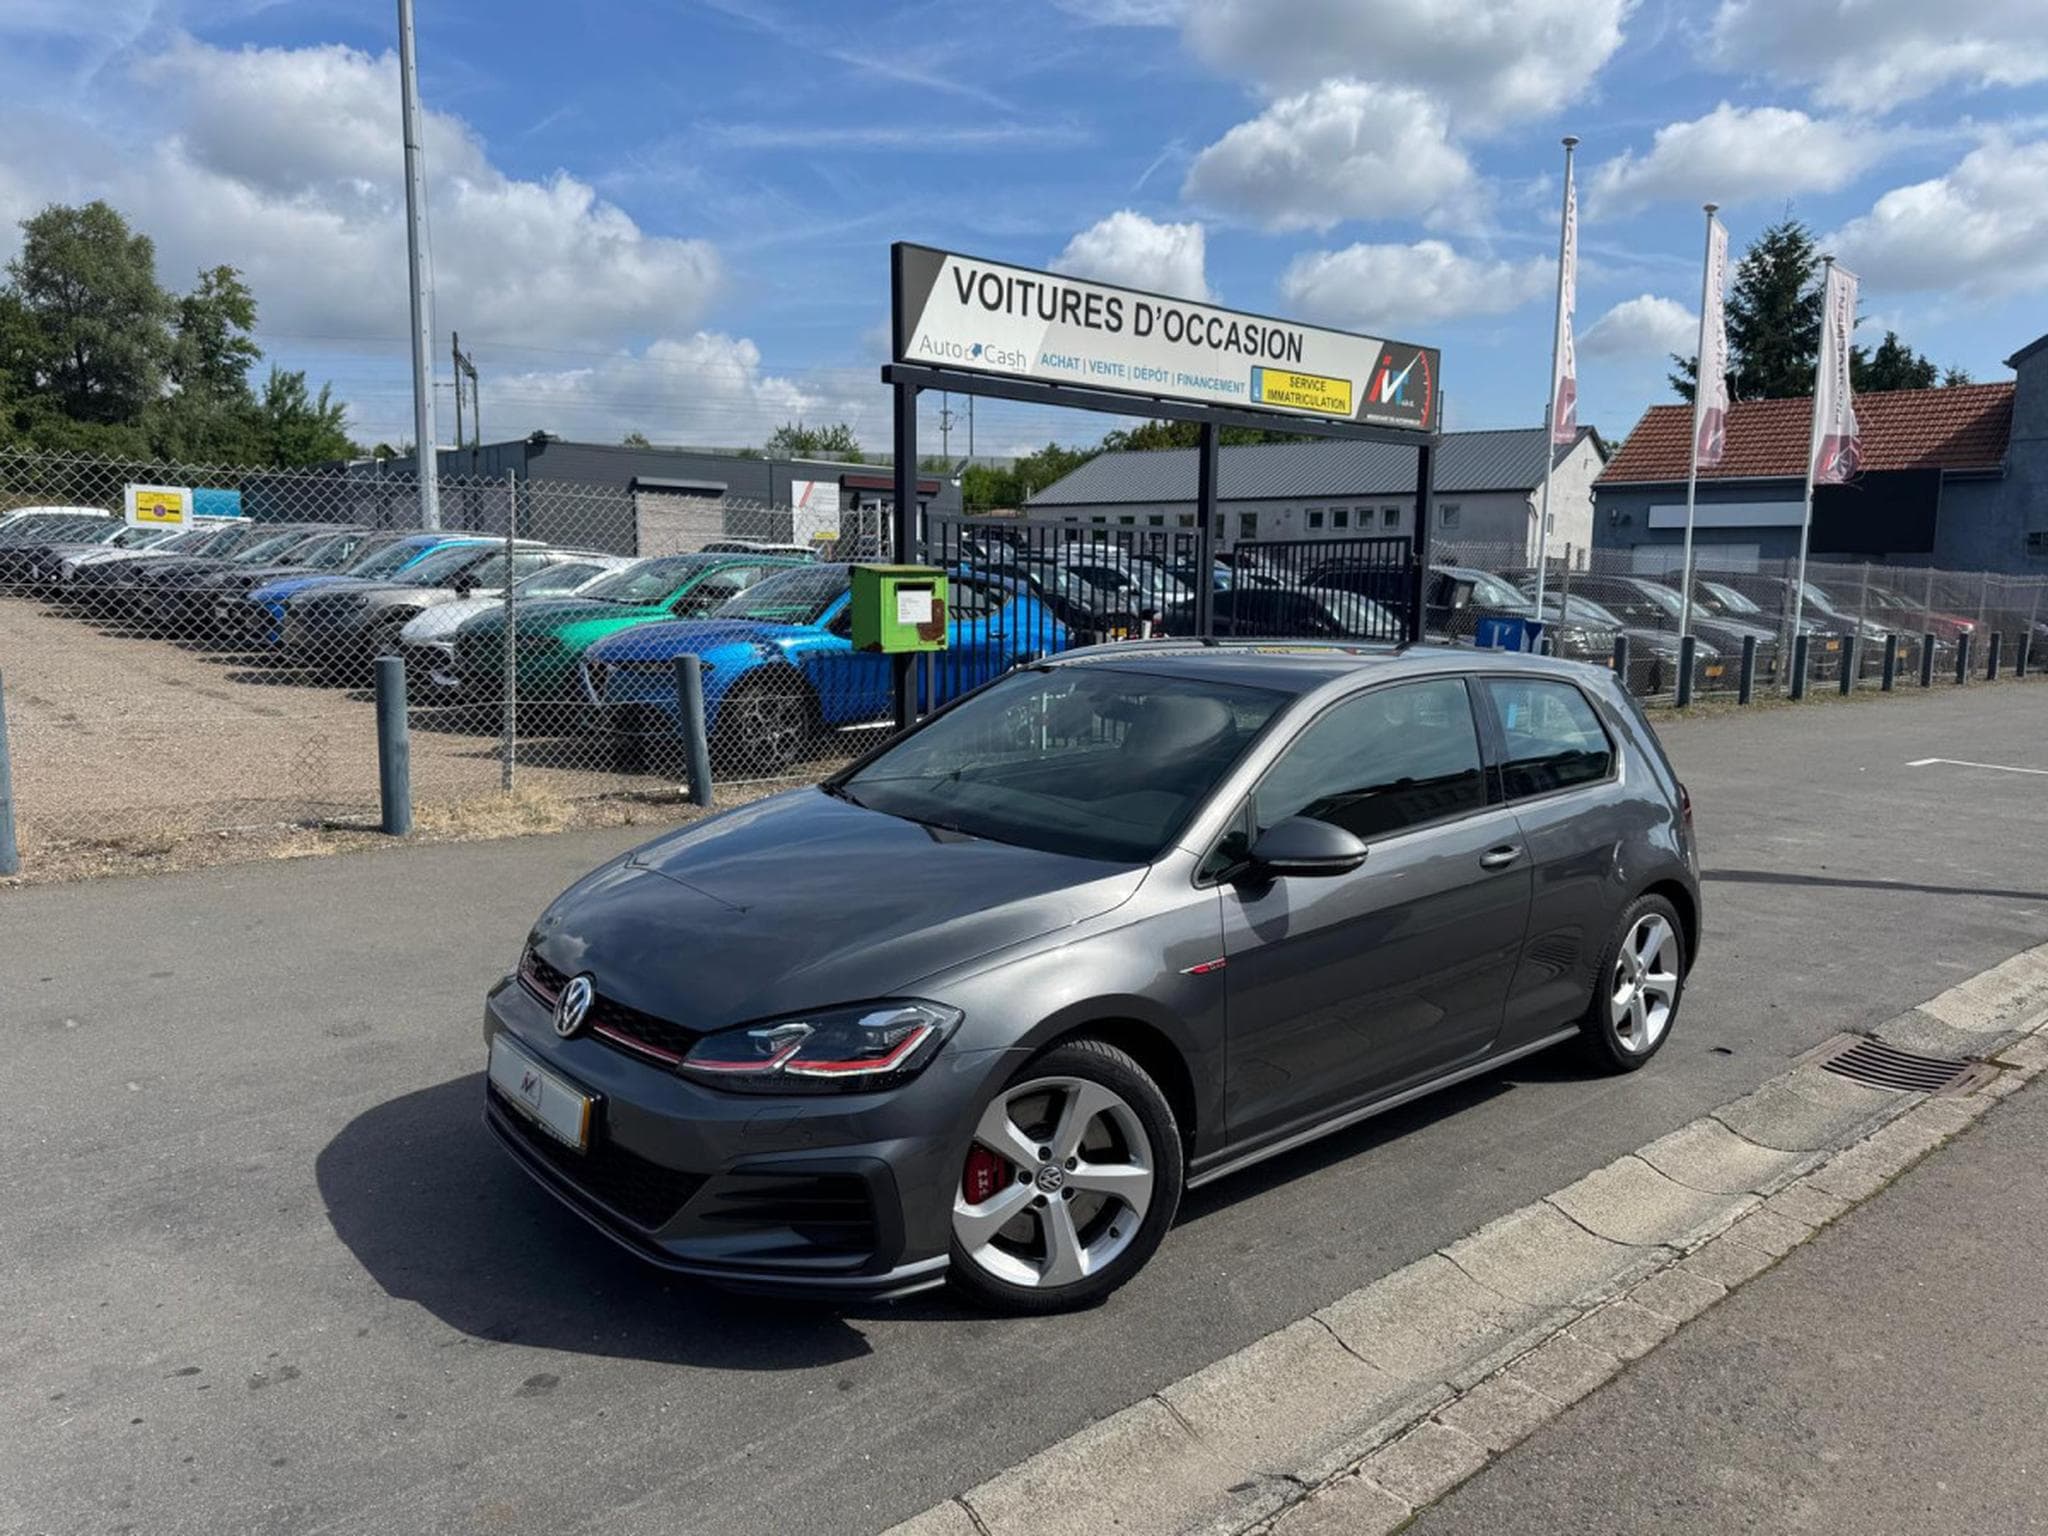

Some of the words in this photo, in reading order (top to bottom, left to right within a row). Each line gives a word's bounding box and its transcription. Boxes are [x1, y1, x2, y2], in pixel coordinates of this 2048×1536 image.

[953, 266, 1124, 334] VOITURES
[1134, 302, 1303, 363] D'OCCASION
[919, 334, 963, 358] Auto
[983, 344, 1027, 368] Cash
[1040, 353, 1080, 371] ACHAT
[1089, 360, 1125, 378] VENTE
[1176, 373, 1245, 394] FINANCEMENT
[1288, 376, 1327, 392] SERVICE
[1267, 389, 1346, 410] IMMATRICULATION
